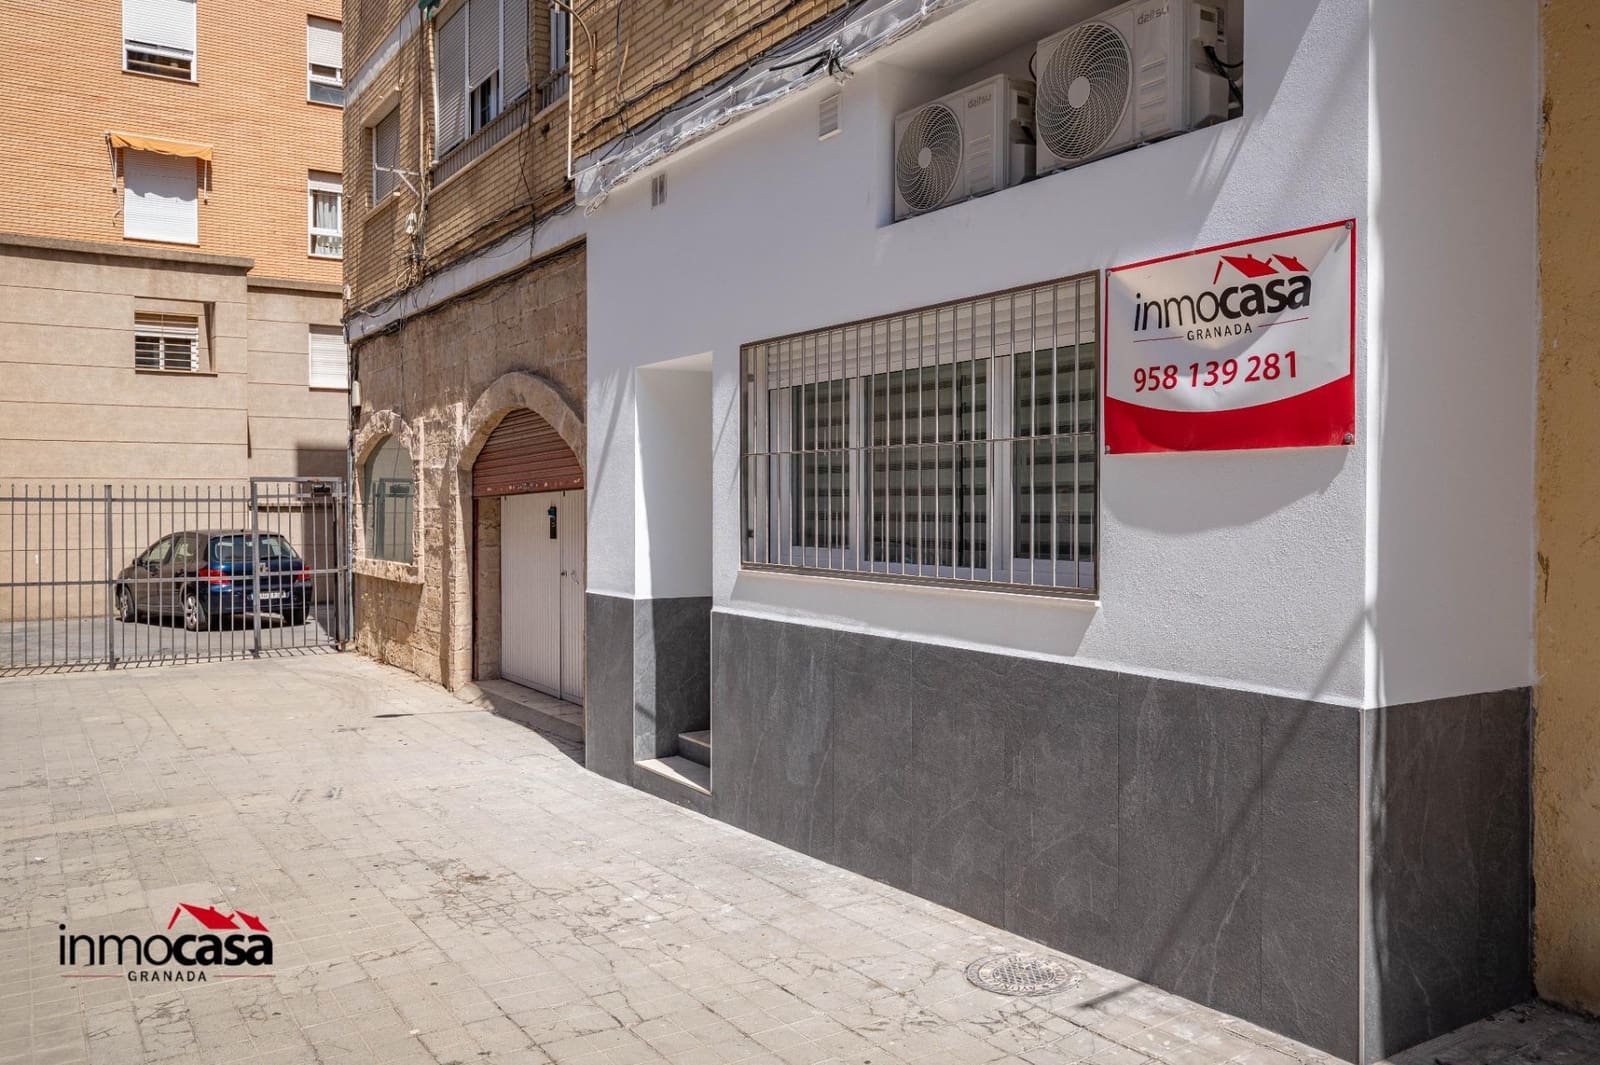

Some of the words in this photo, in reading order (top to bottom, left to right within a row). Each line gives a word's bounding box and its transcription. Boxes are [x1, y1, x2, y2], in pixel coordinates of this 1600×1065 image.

[1134, 275, 1312, 331] inmocasa
[1186, 322, 1253, 341] GRANADA
[1134, 365, 1178, 392] 958
[1190, 359, 1239, 387] 139
[1244, 351, 1297, 383] 281
